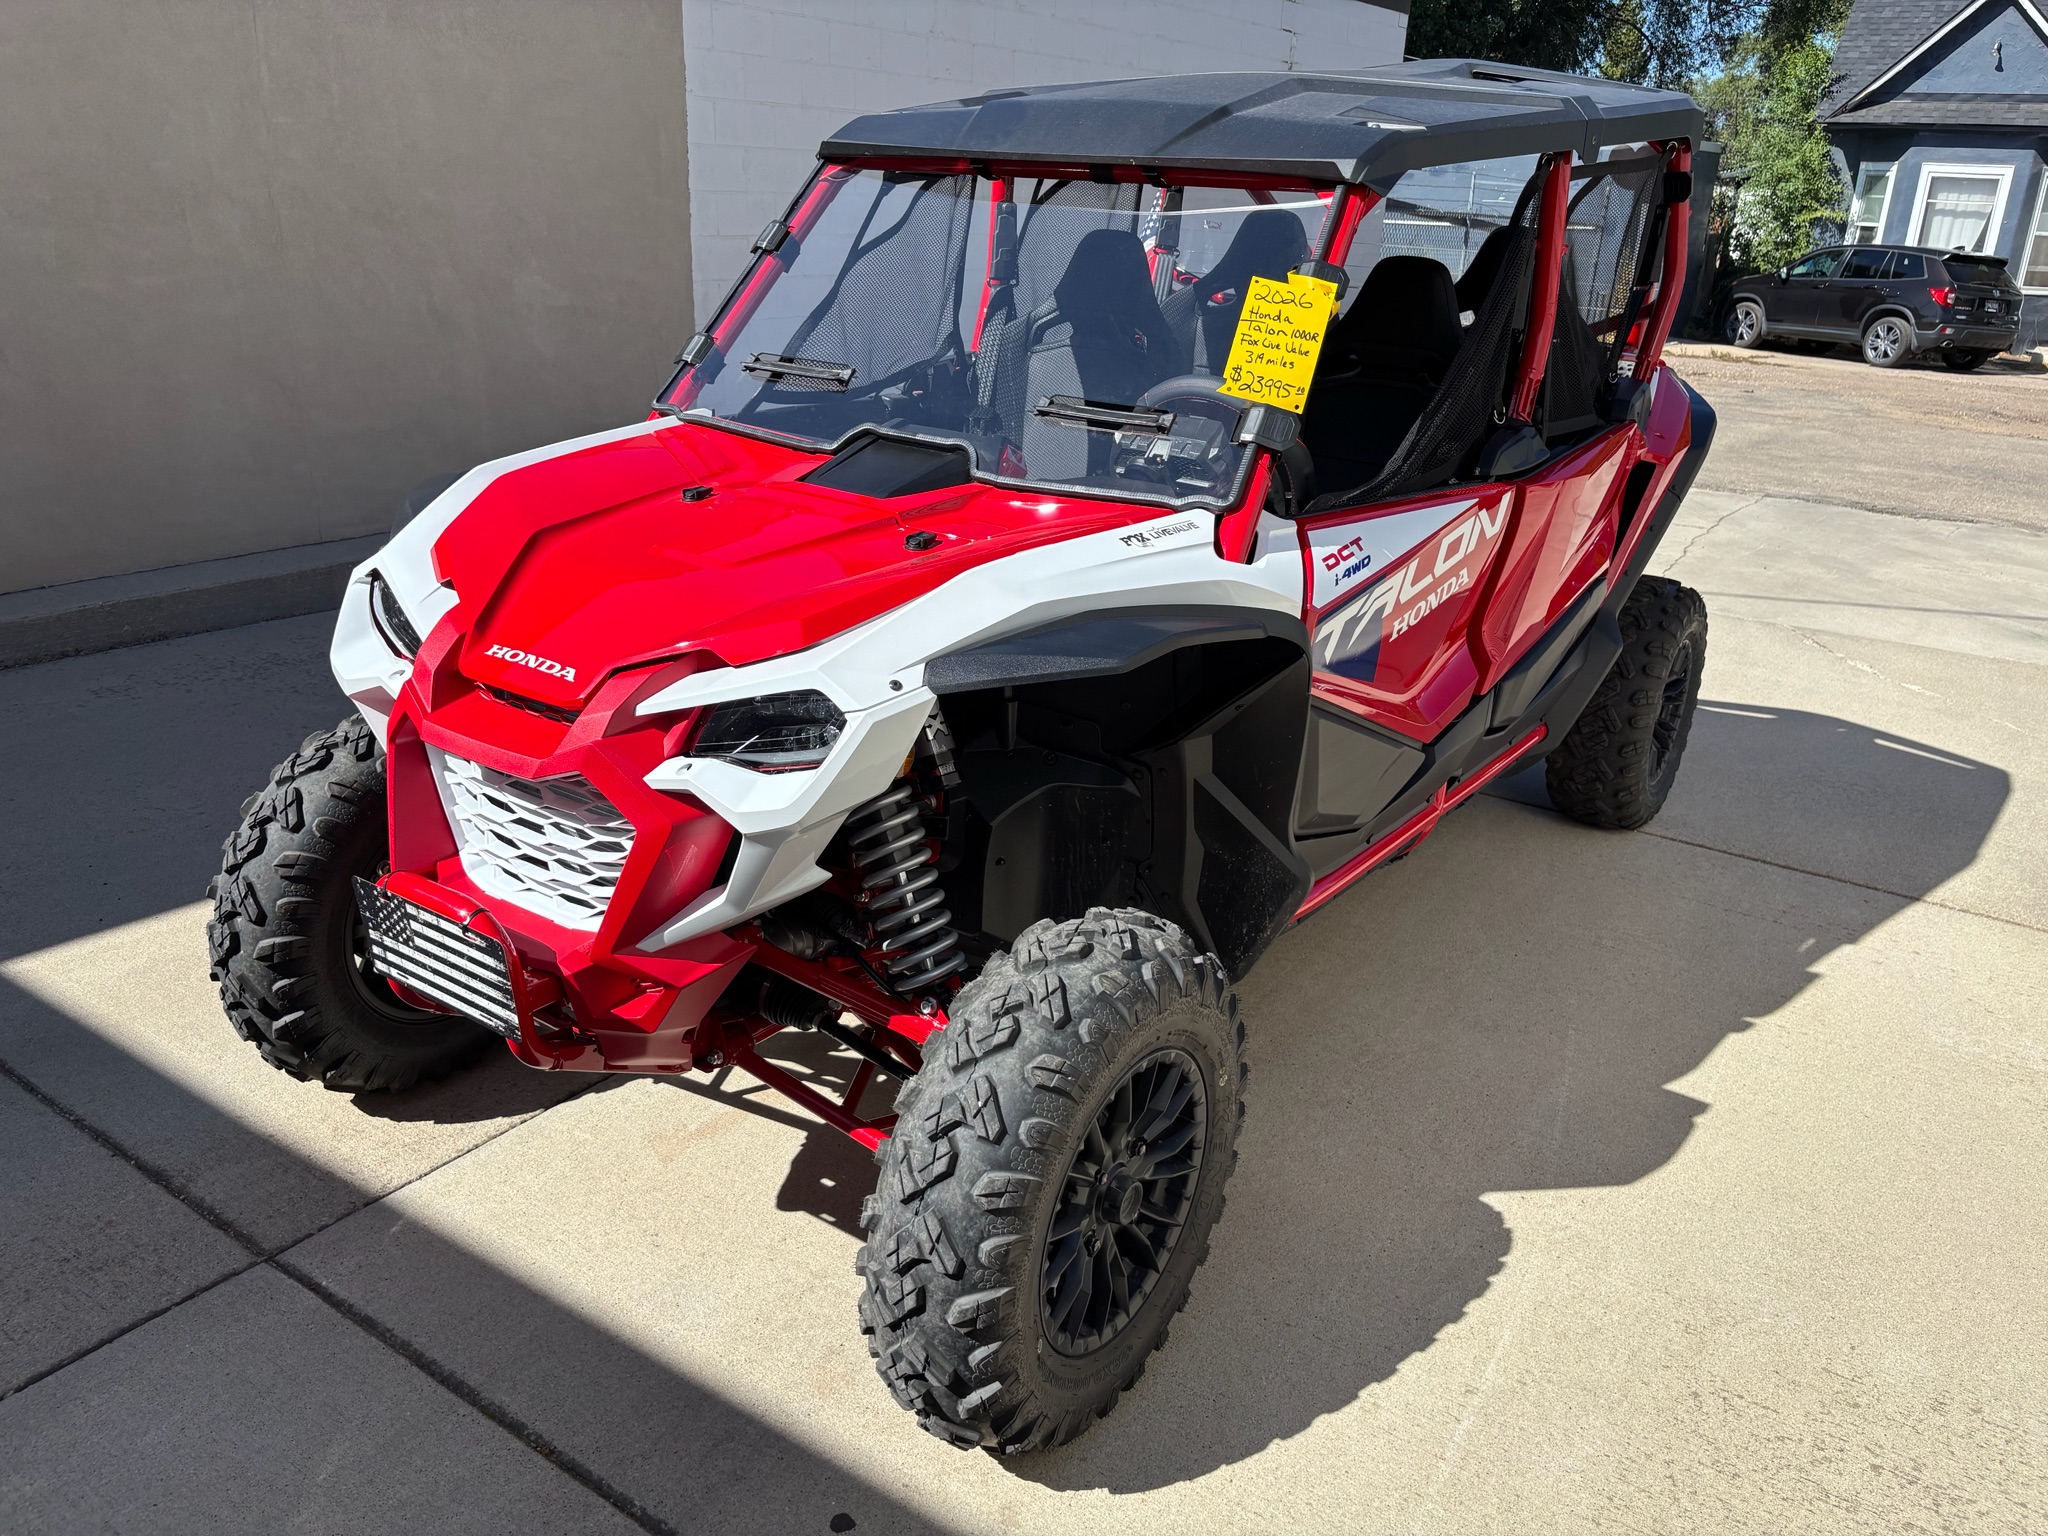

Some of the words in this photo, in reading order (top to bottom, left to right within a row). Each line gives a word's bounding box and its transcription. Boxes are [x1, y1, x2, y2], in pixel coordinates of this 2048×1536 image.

[1254, 284, 1313, 309] 2026
[1249, 305, 1294, 324] Honda
[1240, 318, 1288, 337] Talon
[1290, 329, 1319, 343] 1000R
[1240, 333, 1259, 346] Fox
[1262, 338, 1281, 350] Live
[1266, 357, 1294, 369] miles
[1119, 532, 1151, 547] FOX
[1321, 536, 1363, 572] DCT
[1314, 490, 1512, 665] TALON
[1335, 554, 1371, 587] i-4WD
[1389, 567, 1469, 643] HONDA
[484, 643, 577, 682] HONDA
